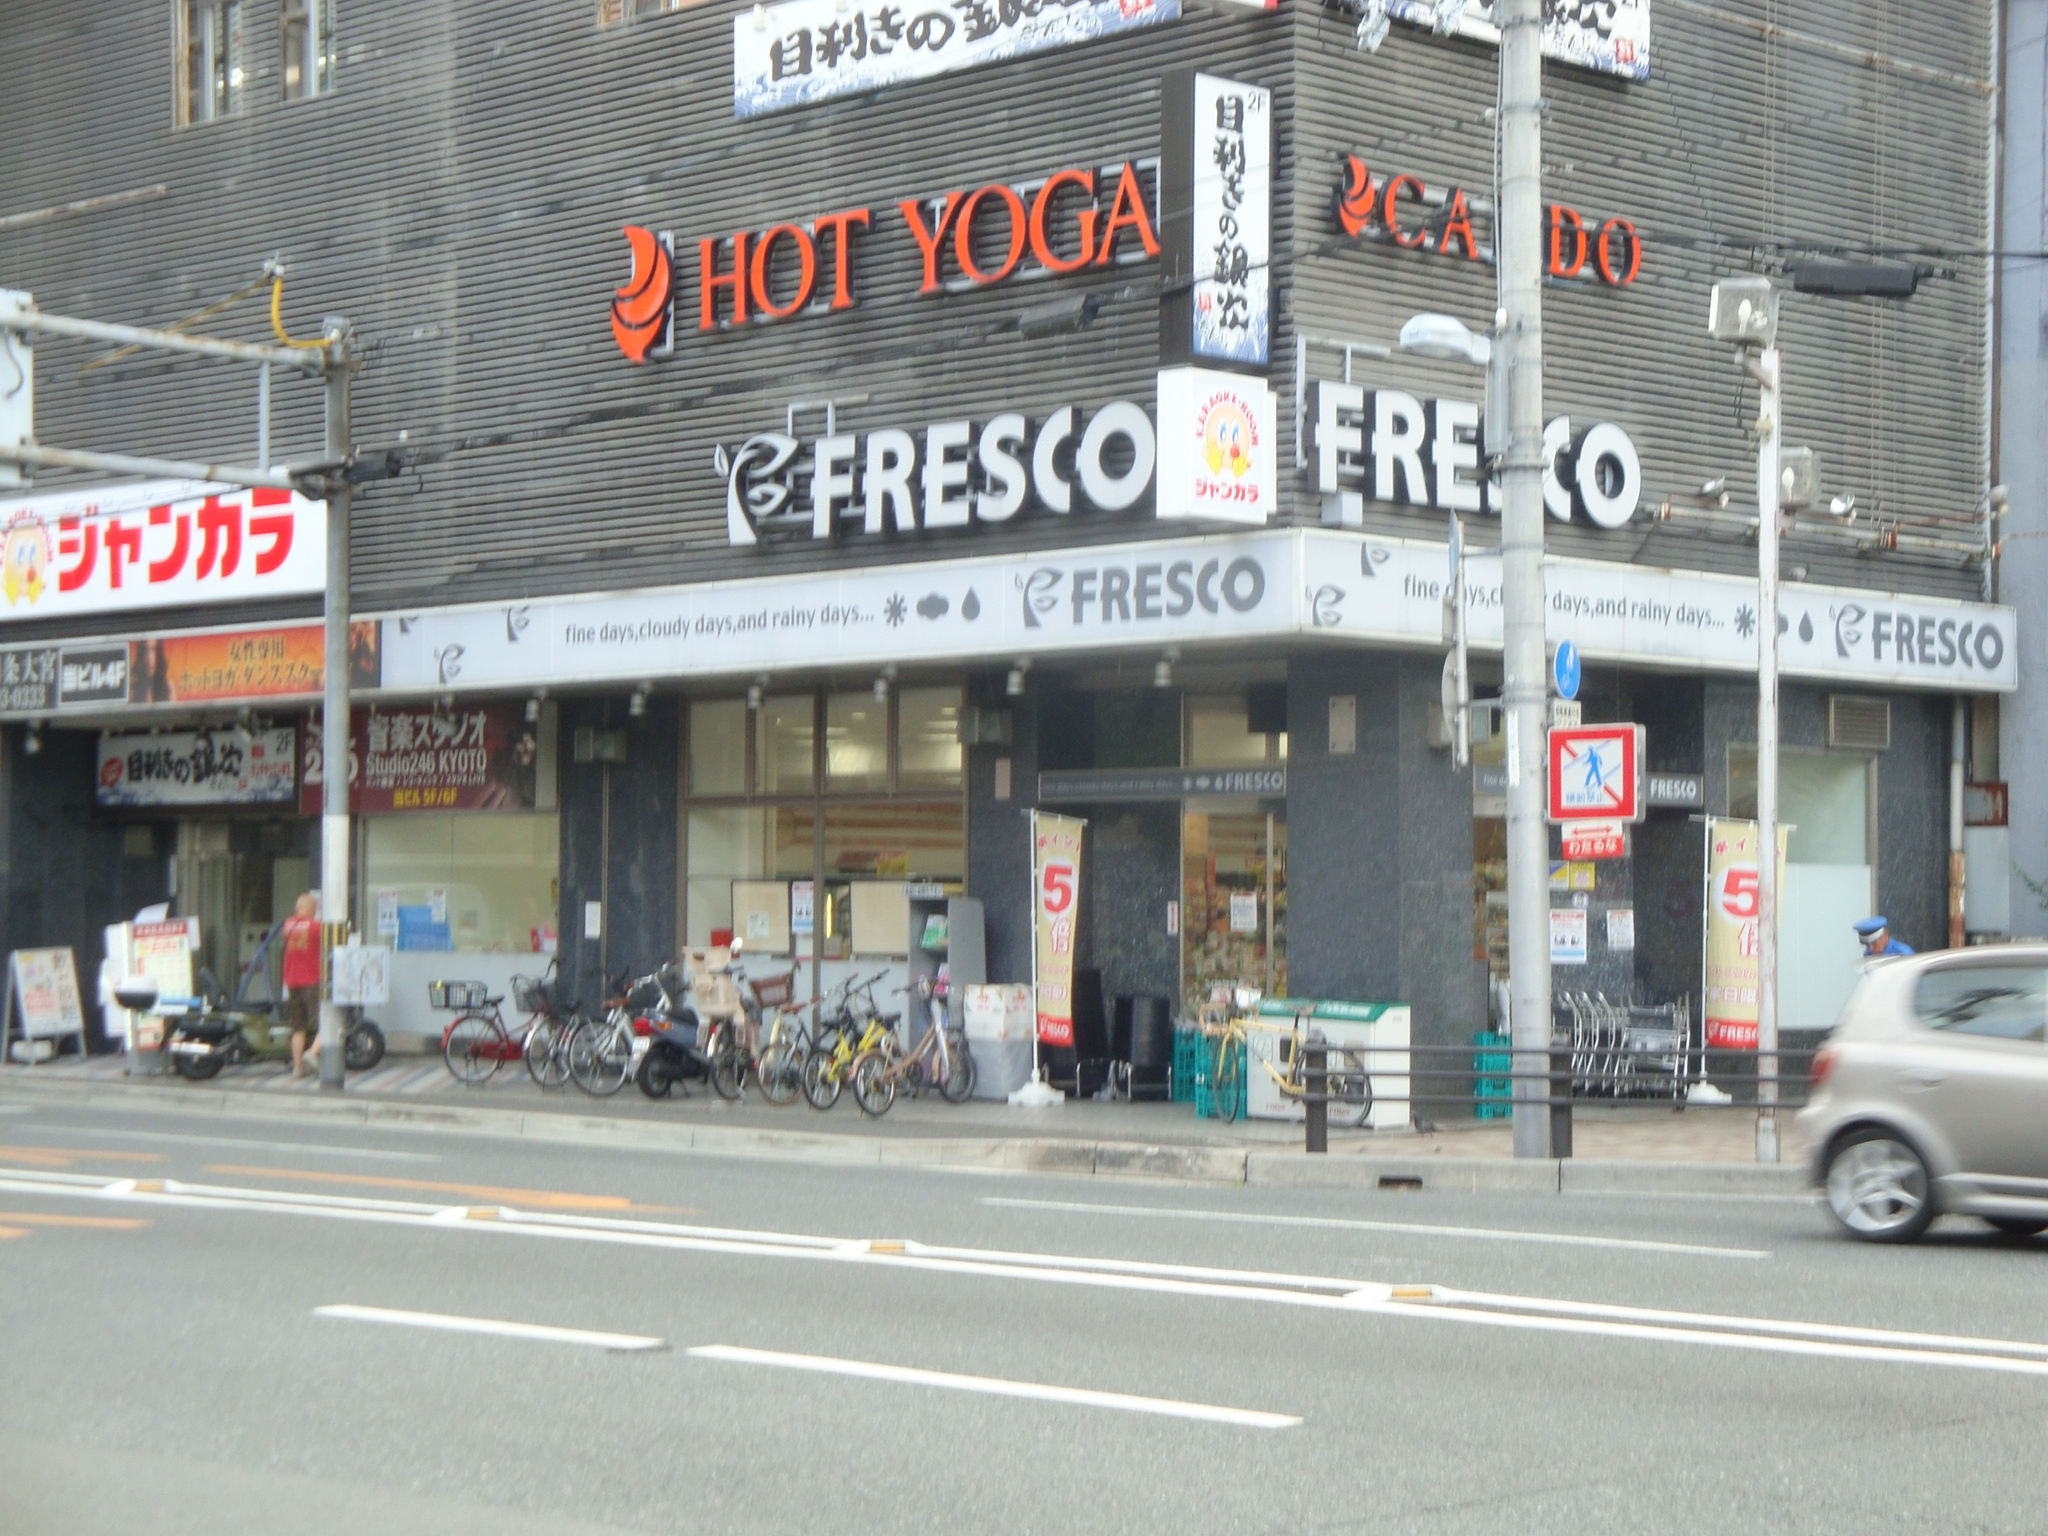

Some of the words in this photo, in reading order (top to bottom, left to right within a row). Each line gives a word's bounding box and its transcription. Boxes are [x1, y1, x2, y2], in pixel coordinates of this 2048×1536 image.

[1247, 91, 1267, 114] 2F
[700, 208, 870, 330] HOT
[899, 161, 1160, 294] YOGA
[1384, 173, 1642, 287] CADO
[811, 400, 1156, 539] FRESCO
[1314, 379, 1642, 529] FRECO
[1195, 476, 1260, 504] ジャンカラ
[58, 486, 294, 593] ジャンカラ
[1071, 555, 1266, 627] FRESCO
[1403, 573, 1440, 600] fine
[1631, 598, 1672, 625] rainy
[565, 622, 596, 645] fine
[772, 604, 816, 629] rainy
[1872, 610, 2004, 670] FRESCO
[231, 636, 284, 661] 女性専用
[62, 660, 126, 689] 当ビル4F
[366, 750, 435, 776] Studio246
[439, 748, 487, 774] KYOTO
[1225, 771, 1284, 792] FRESCO
[1650, 779, 1697, 800] FRESCO
[1568, 837, 1618, 856] わたるな
[1043, 864, 1073, 913] 5
[1722, 867, 1759, 918] 5
[1051, 917, 1071, 955] 倍
